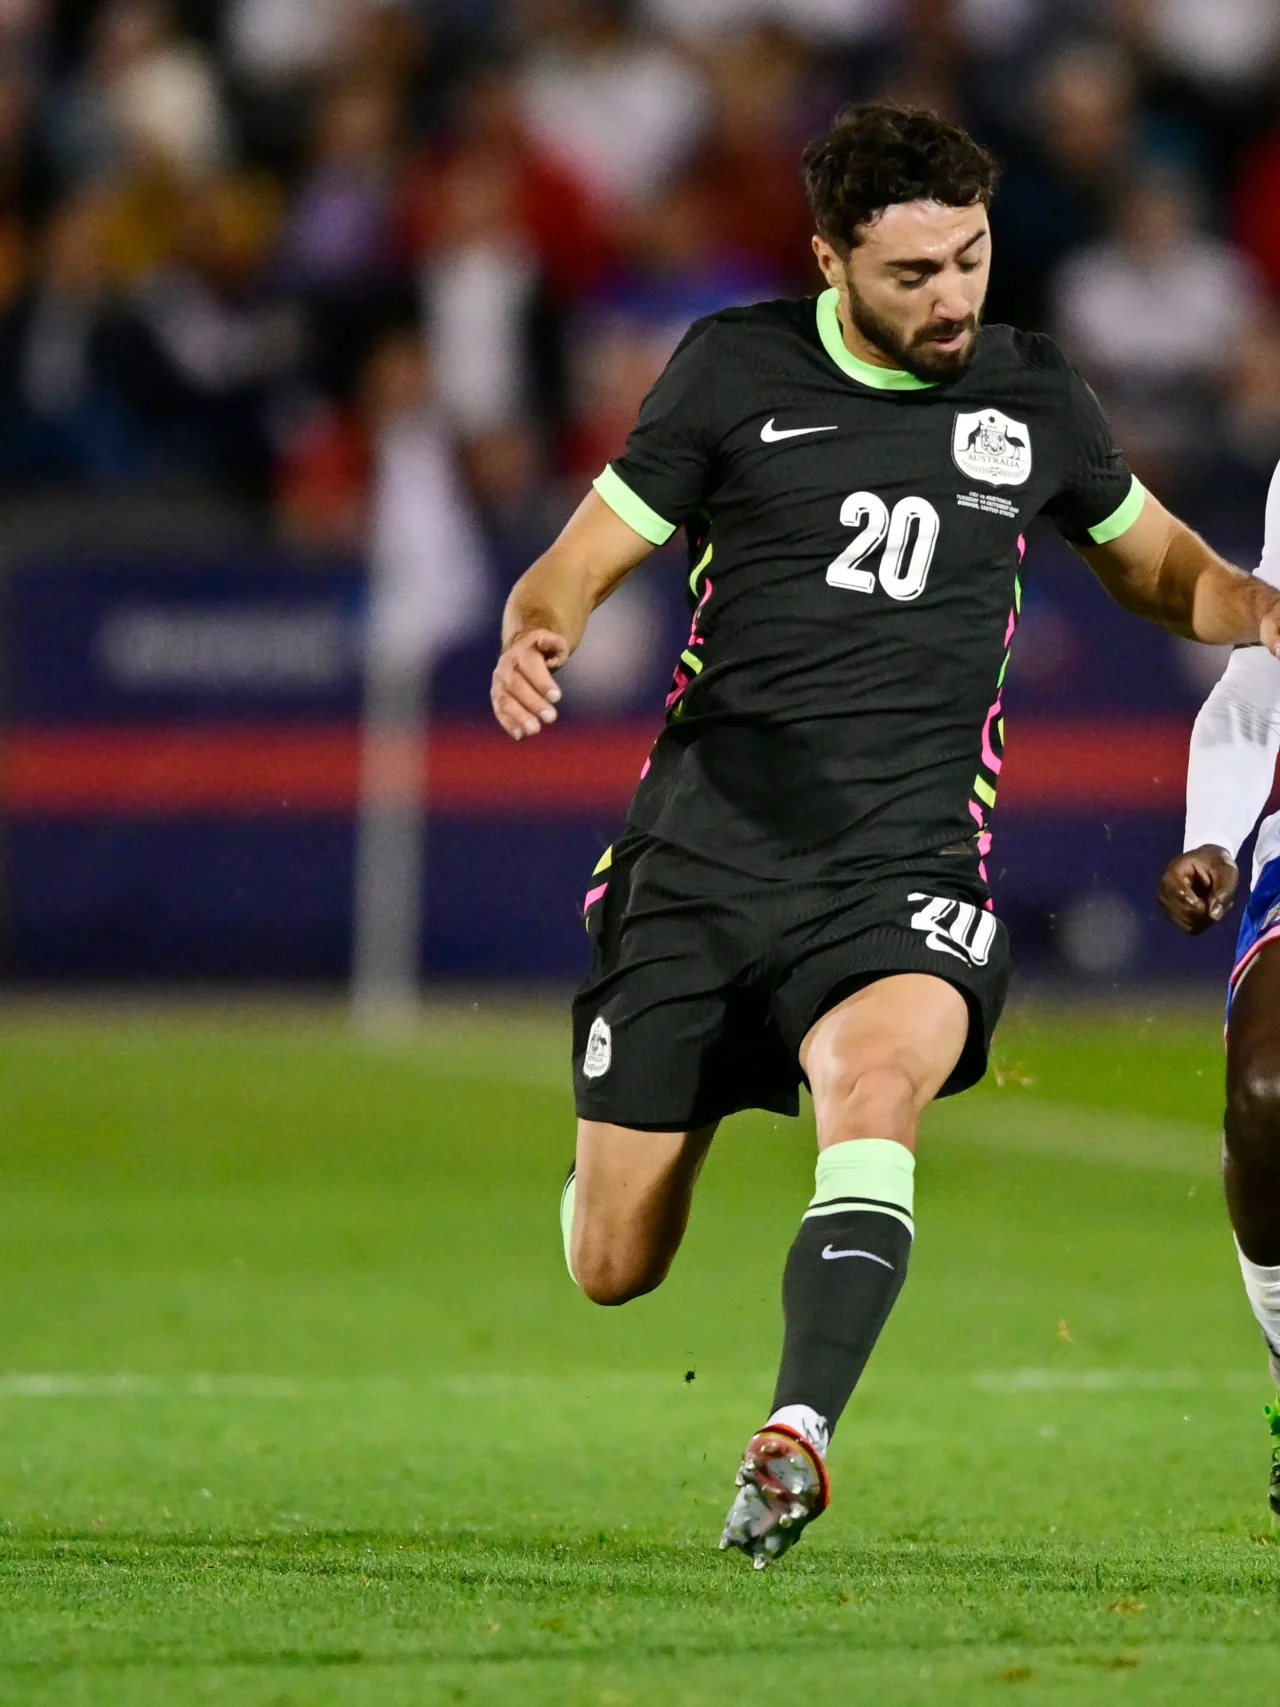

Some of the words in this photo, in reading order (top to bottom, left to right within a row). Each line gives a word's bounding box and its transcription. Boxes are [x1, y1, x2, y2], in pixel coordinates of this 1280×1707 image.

[968, 454, 1020, 469] AUSTRALIA
[956, 494, 980, 503] TUESDAY
[986, 500, 1010, 511] OCTOBER
[986, 494, 1012, 506] AUSTRALIA
[980, 504, 999, 514] UNITED
[999, 509, 1016, 518] STATES
[826, 491, 940, 601] 20
[907, 892, 997, 969] 20
